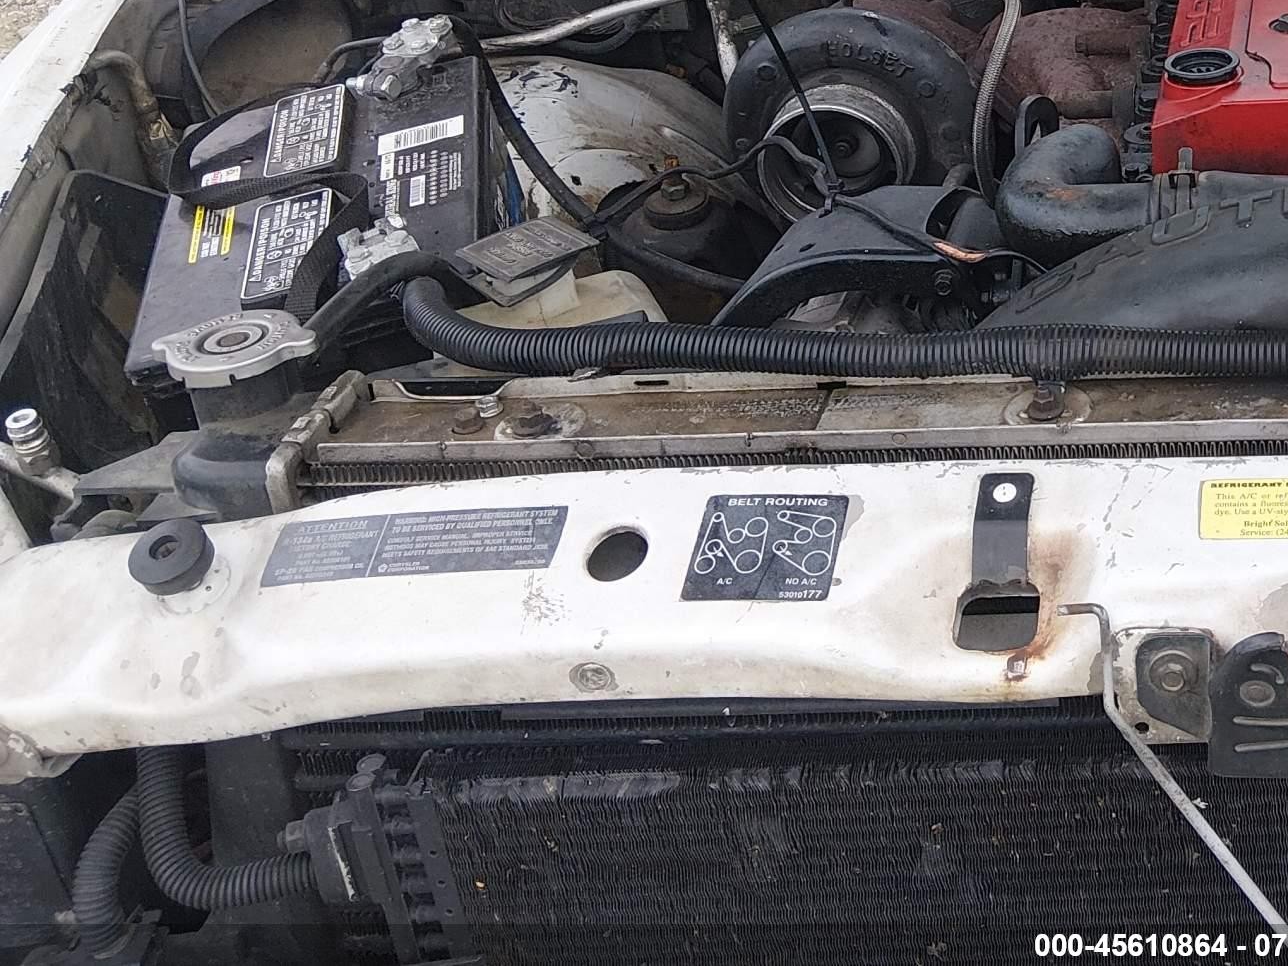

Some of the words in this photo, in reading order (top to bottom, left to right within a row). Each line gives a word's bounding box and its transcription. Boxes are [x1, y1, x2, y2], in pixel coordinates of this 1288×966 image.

[825, 40, 915, 77] HOLSET
[253, 217, 272, 277] DANGER/POISON
[728, 498, 761, 507] BELT
[765, 498, 828, 507] ROUTING
[481, 511, 530, 520] REFRIGERANT
[530, 509, 558, 517] SYSTEM
[299, 520, 368, 533] ATTENTION
[392, 526, 401, 534] TO
[401, 525, 411, 533] BE
[412, 524, 444, 532] SERVICED
[445, 522, 456, 530] BY
[456, 520, 492, 529] QUALIFIED
[492, 519, 533, 527] PERSONNEL
[1244, 519, 1271, 527] Bright
[328, 530, 379, 541] REFRIGERANT
[1240, 528, 1273, 536] Service:
[716, 577, 733, 585] A/C
[785, 577, 799, 585] NO
[800, 577, 817, 585] A/C
[778, 589, 823, 599] 53010177
